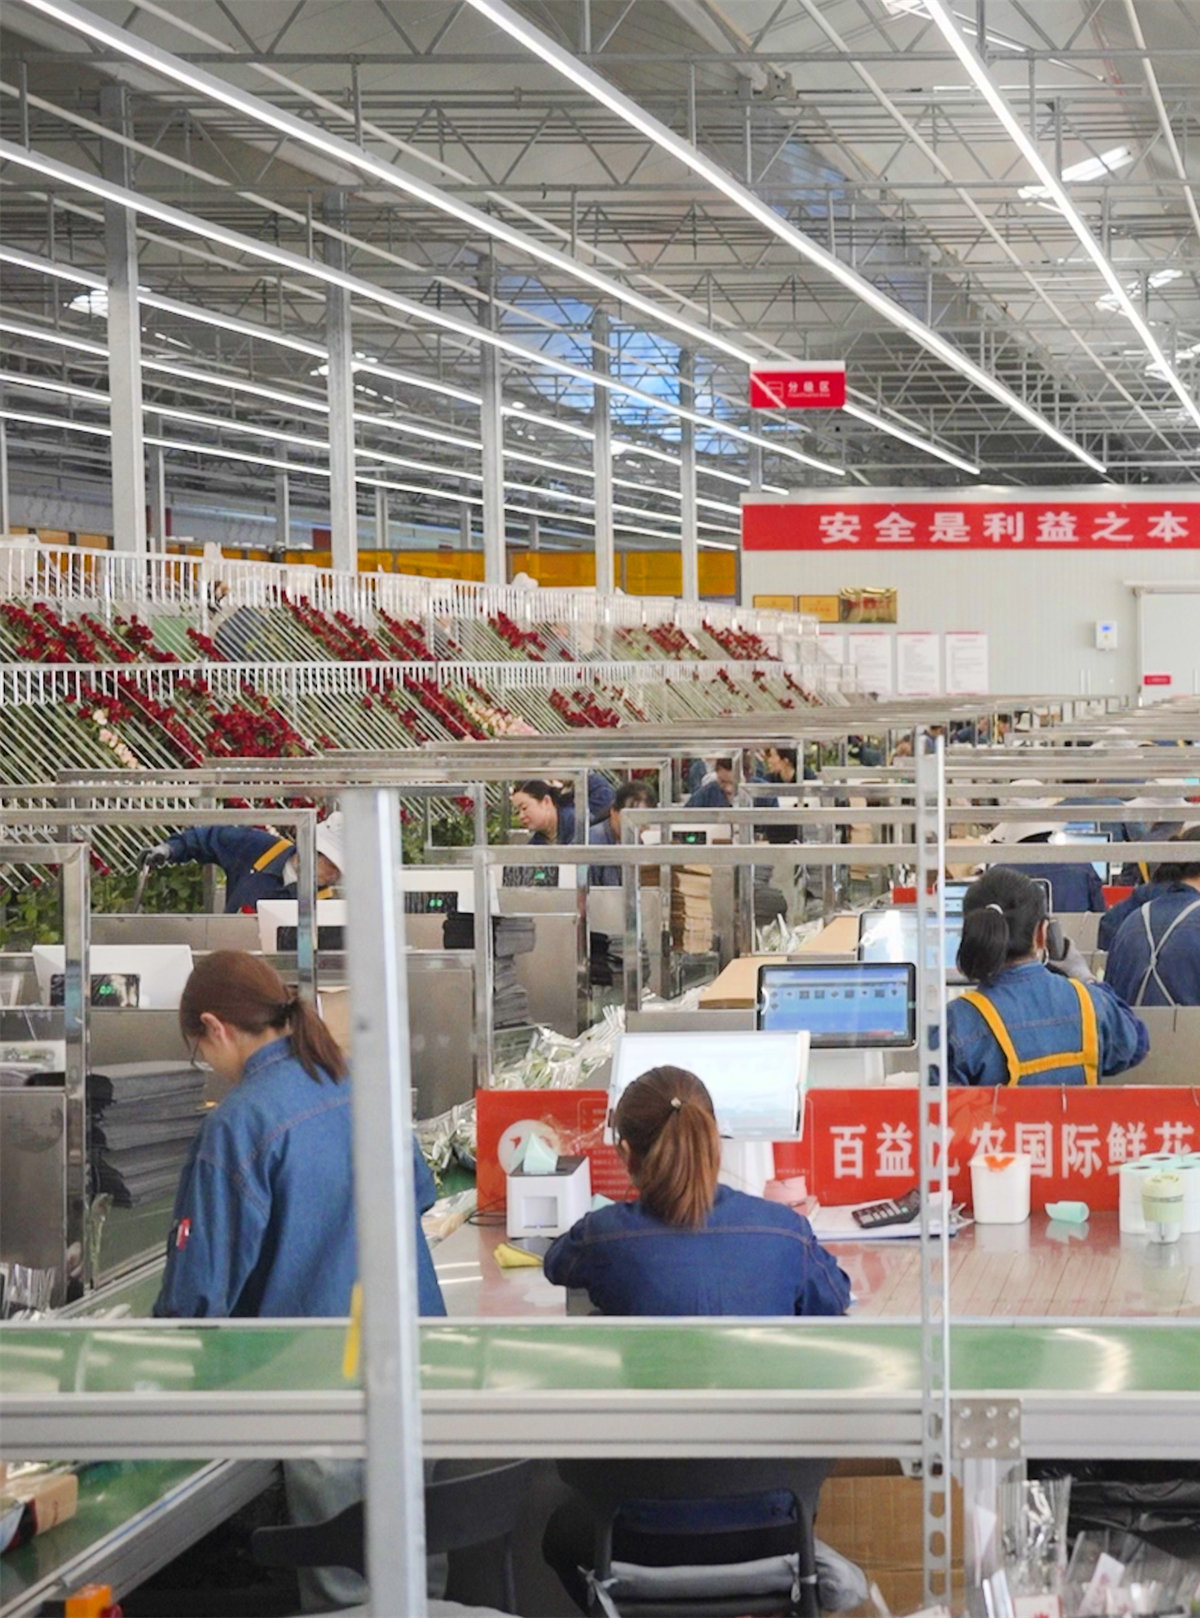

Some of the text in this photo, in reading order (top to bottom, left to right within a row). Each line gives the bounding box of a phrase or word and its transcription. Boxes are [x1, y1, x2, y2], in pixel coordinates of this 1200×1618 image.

[819, 511, 1189, 543] 安全是利益之本
